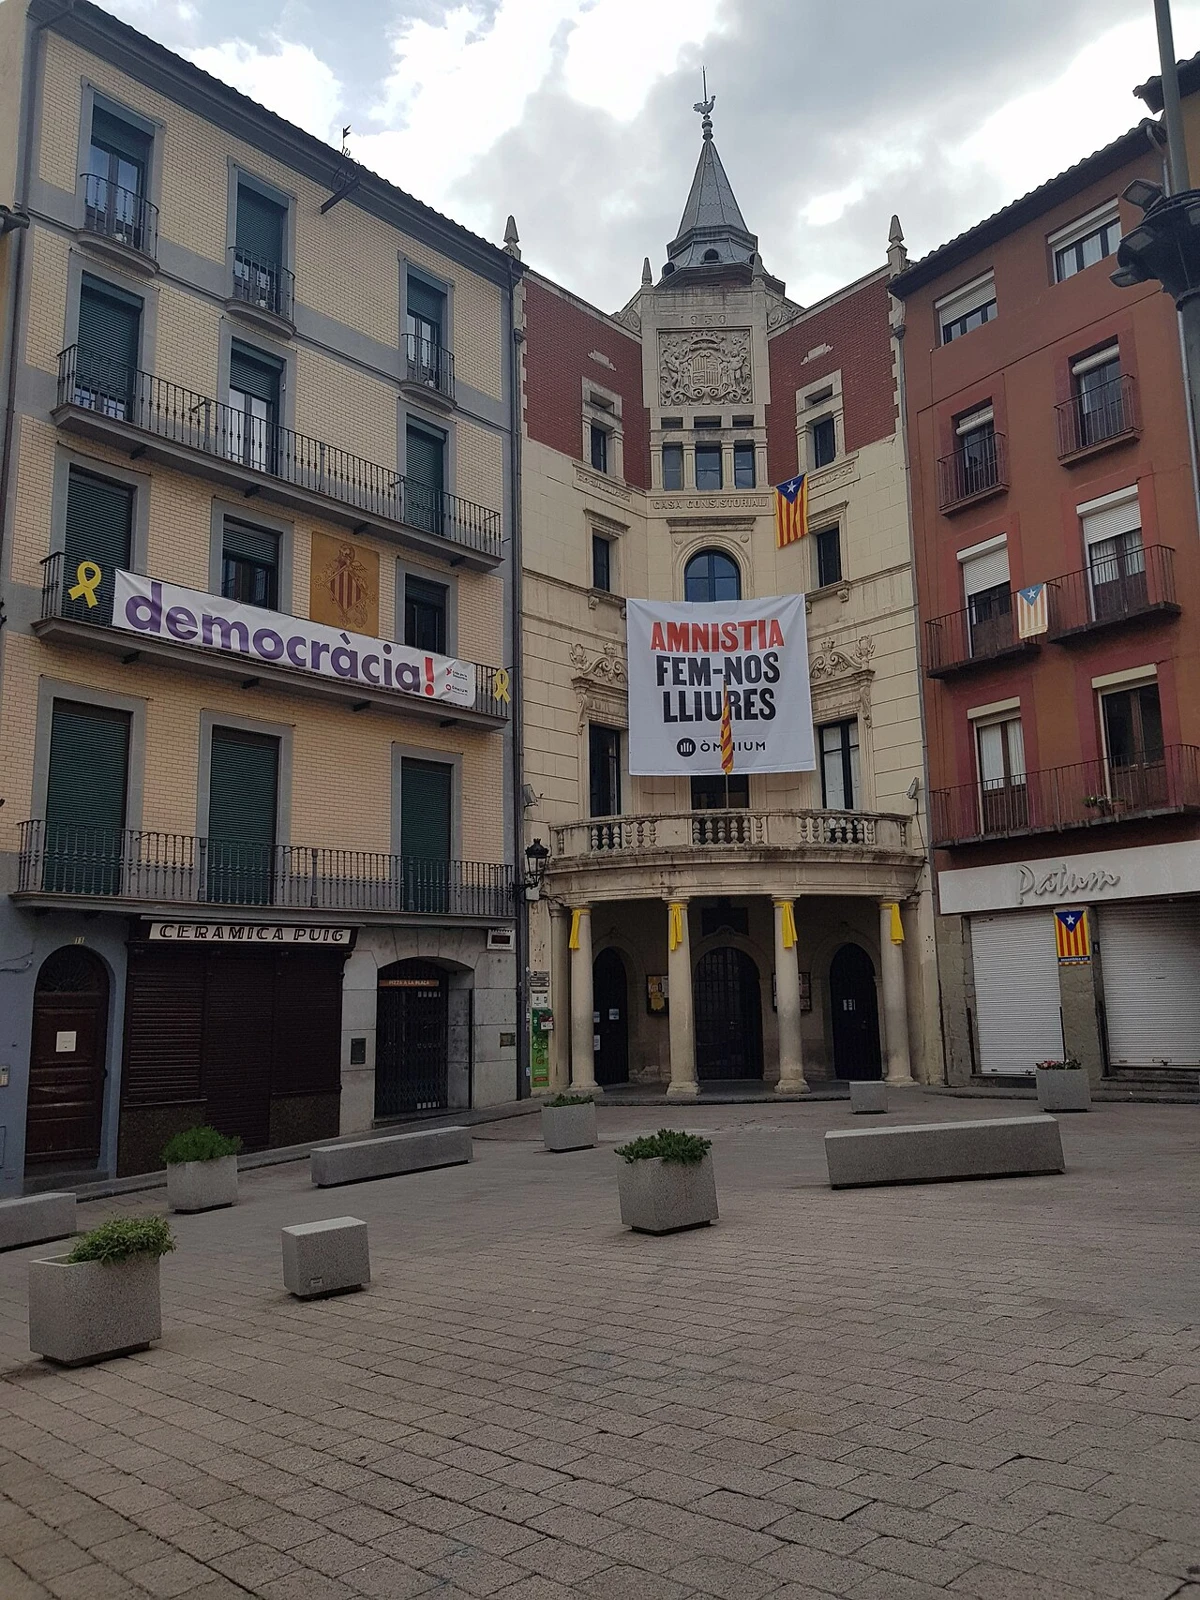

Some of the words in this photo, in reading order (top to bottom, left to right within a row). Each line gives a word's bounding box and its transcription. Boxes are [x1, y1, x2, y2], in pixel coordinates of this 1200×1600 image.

[653, 500, 682, 510] CASA
[686, 497, 767, 509] CONSISTORIAL
[125, 581, 435, 697] democràcia!
[651, 619, 785, 653] AMNISTIA
[656, 652, 780, 687] FEM-NOS
[663, 687, 776, 723] LLIURES
[1018, 863, 1121, 905] Patum
[159, 924, 284, 941] CERAMICA
[293, 928, 344, 942] PUIG
